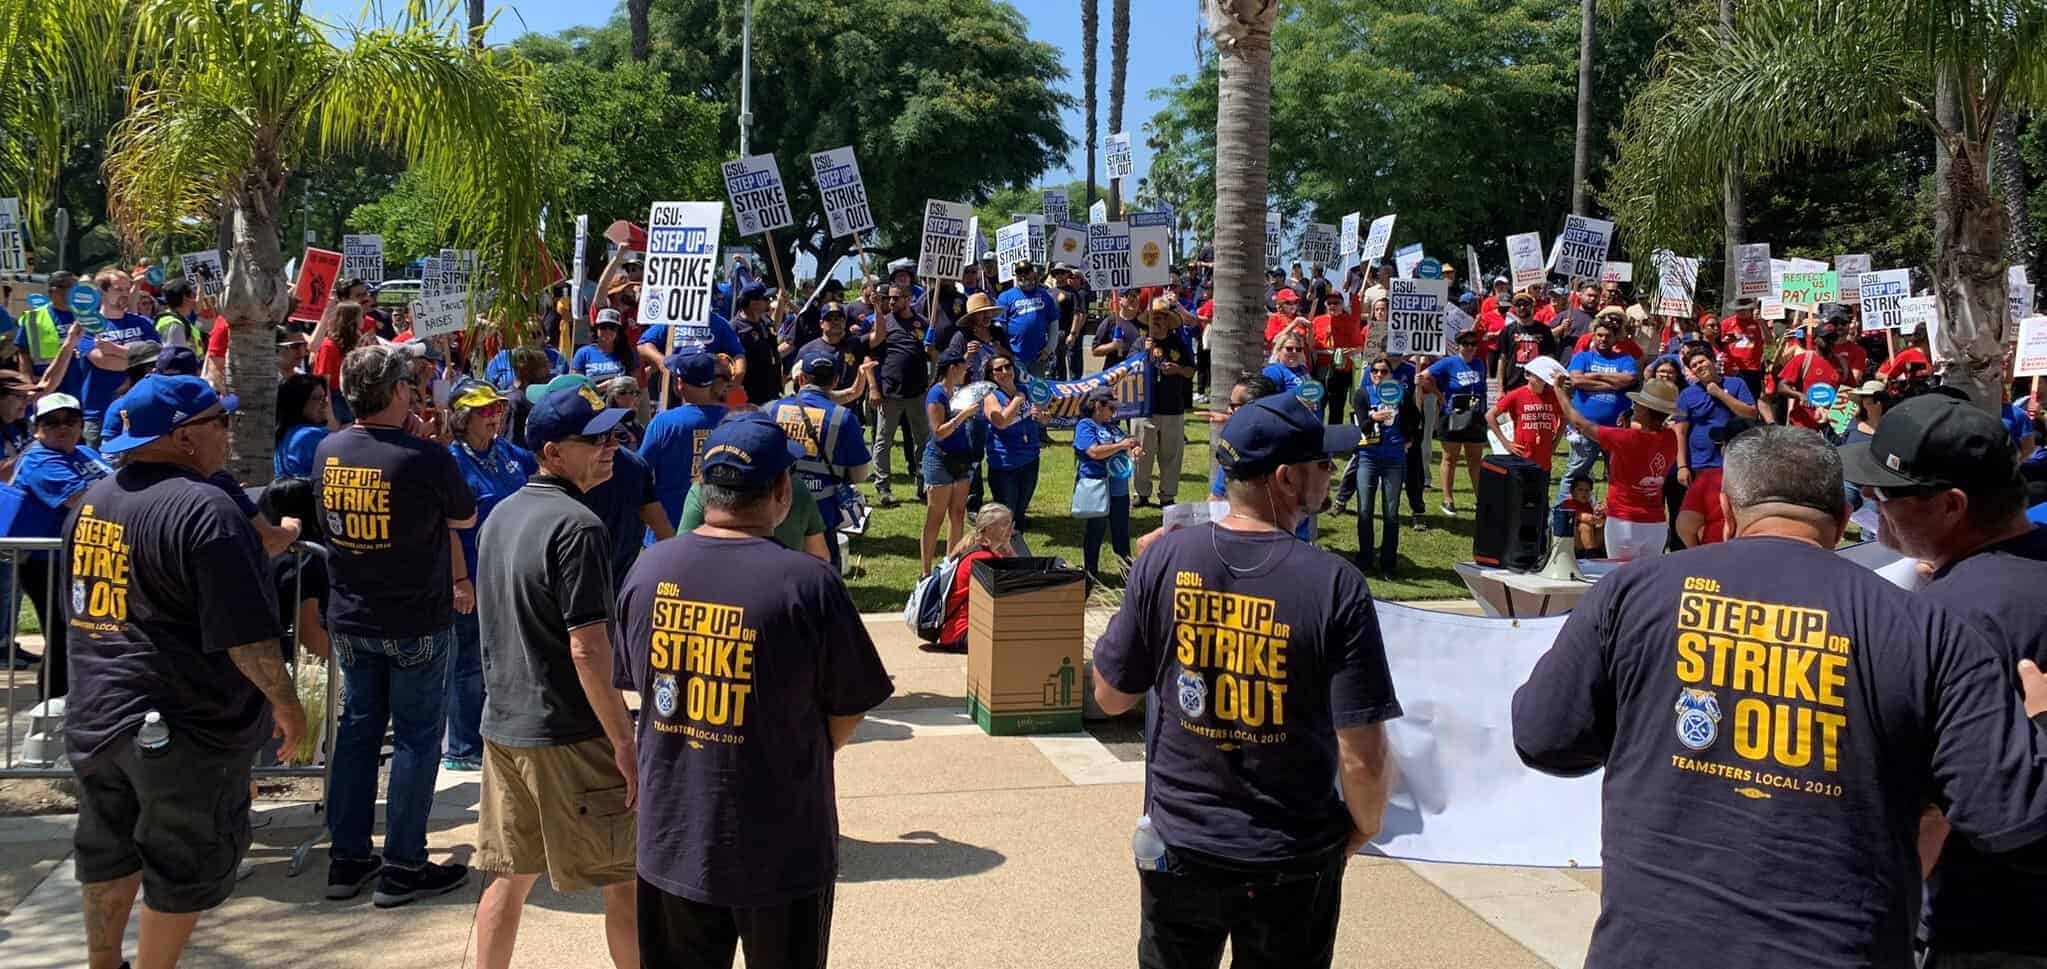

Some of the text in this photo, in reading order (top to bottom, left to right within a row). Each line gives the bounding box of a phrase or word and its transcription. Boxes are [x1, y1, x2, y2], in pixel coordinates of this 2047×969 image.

[814, 154, 834, 170] CSU:
[1107, 152, 1131, 165] STRIKE
[725, 162, 747, 176] CSU:
[820, 167, 852, 189] STEP UP
[1118, 163, 1132, 176] OUT
[729, 172, 770, 193] STEP UP
[734, 186, 784, 213] STRIKE
[824, 184, 865, 211] STRIKE
[654, 207, 682, 225] CSU:
[759, 204, 788, 228] OUT
[846, 204, 870, 229] OUT
[929, 202, 947, 216] CSU:
[1045, 205, 1068, 215] STRIKE
[928, 219, 961, 235] STEP UP
[1090, 225, 1110, 236] CSU:
[1568, 217, 1587, 229] CSU:
[652, 230, 685, 252] STEP
[686, 230, 705, 252] UP
[1092, 237, 1129, 250] STEP UP
[1566, 229, 1602, 244] STEP UP
[925, 235, 965, 257] STRIKE
[1000, 245, 1027, 265] STRIKE
[1305, 241, 1331, 252] STRIKE
[1562, 241, 1604, 261] STRIKE
[347, 256, 381, 268] STRIKE
[1092, 252, 1130, 270] STRIK
[1314, 251, 1330, 262] OUT
[360, 269, 380, 280] OUT
[648, 256, 711, 287] STRIKE
[938, 256, 963, 277] OUT
[1575, 260, 1602, 278] OUT
[1112, 269, 1130, 287] OU
[1783, 272, 1825, 282] RESPECT
[1812, 278, 1829, 288] US!
[1860, 274, 1881, 284] CSU:
[1393, 281, 1416, 293] CSU:
[1782, 289, 1811, 303] PAY
[1814, 290, 1838, 302] US!
[1862, 286, 1886, 297] STEP
[1887, 282, 1900, 295] UP
[667, 288, 707, 321] OUT
[1393, 296, 1434, 310] STEP UP
[1902, 303, 1936, 312] FIGHTIN
[1392, 312, 1443, 332] STRIKE
[1883, 311, 1902, 326] OU
[1411, 333, 1442, 352] OUT
[1523, 403, 1553, 412] RIGHTS
[324, 468, 357, 488] STEP
[361, 471, 380, 488] UP
[323, 487, 390, 513] STRIKE
[345, 513, 391, 540] OUT
[1176, 571, 1203, 587] CSU:
[1684, 576, 1721, 592] CSU:
[657, 582, 680, 597] CSU:
[654, 600, 707, 632] STEP
[710, 606, 741, 637] UP
[1176, 591, 1290, 639] STEP UP OR
[1681, 595, 1850, 653] STEP UP OR
[651, 629, 754, 680] STRIKE
[1177, 623, 1288, 679] STRIKE
[1676, 632, 1848, 708] STRIKE
[687, 676, 752, 726] OUT
[1215, 673, 1288, 727] OUT
[654, 720, 744, 744] TEAMSTERS LOCAL 2010
[1180, 719, 1287, 744] TEAMSTERS LOCAL 2010
[1734, 697, 1846, 772] OUT
[1671, 755, 1843, 797] TEAMSTERS LOCAL 2010
